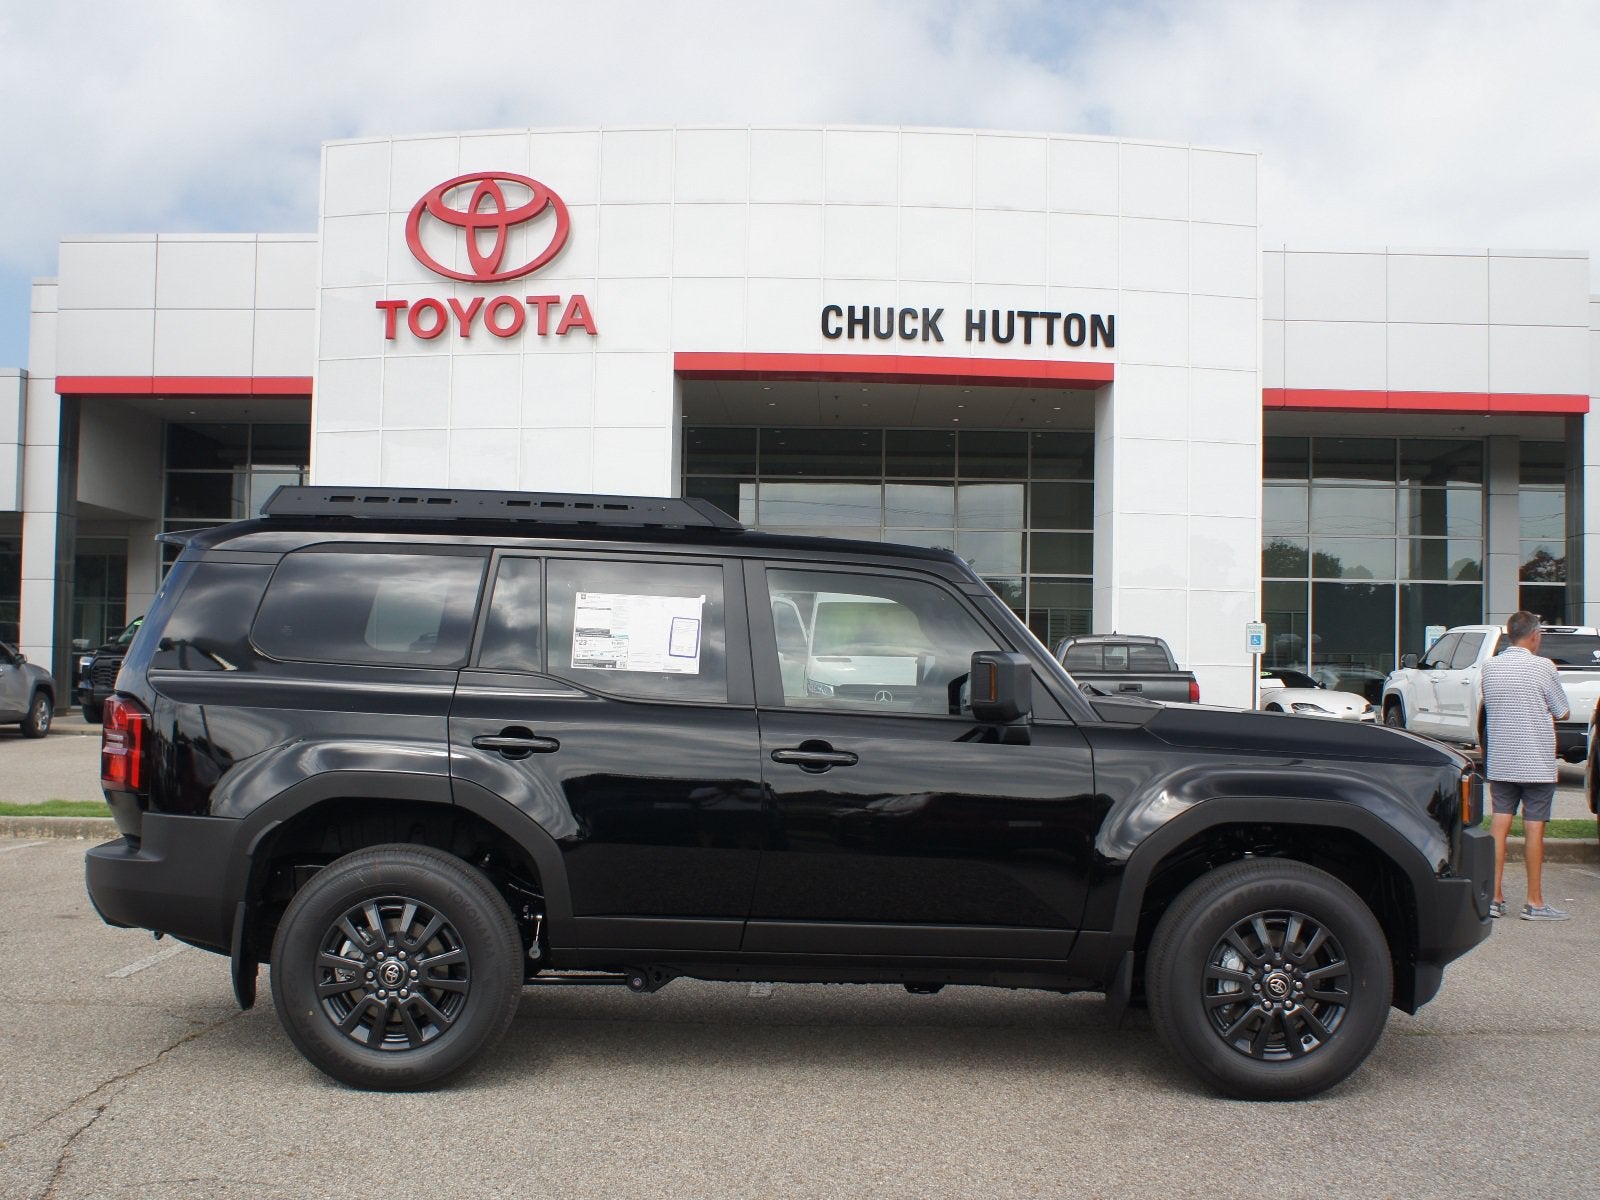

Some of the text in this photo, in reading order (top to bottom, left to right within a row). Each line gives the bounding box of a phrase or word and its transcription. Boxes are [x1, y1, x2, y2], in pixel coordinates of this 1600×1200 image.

[375, 294, 598, 341] TOYOTA
[821, 304, 1116, 348] CHUCK HUTTON
[447, 886, 496, 958] YOKOHAMA
